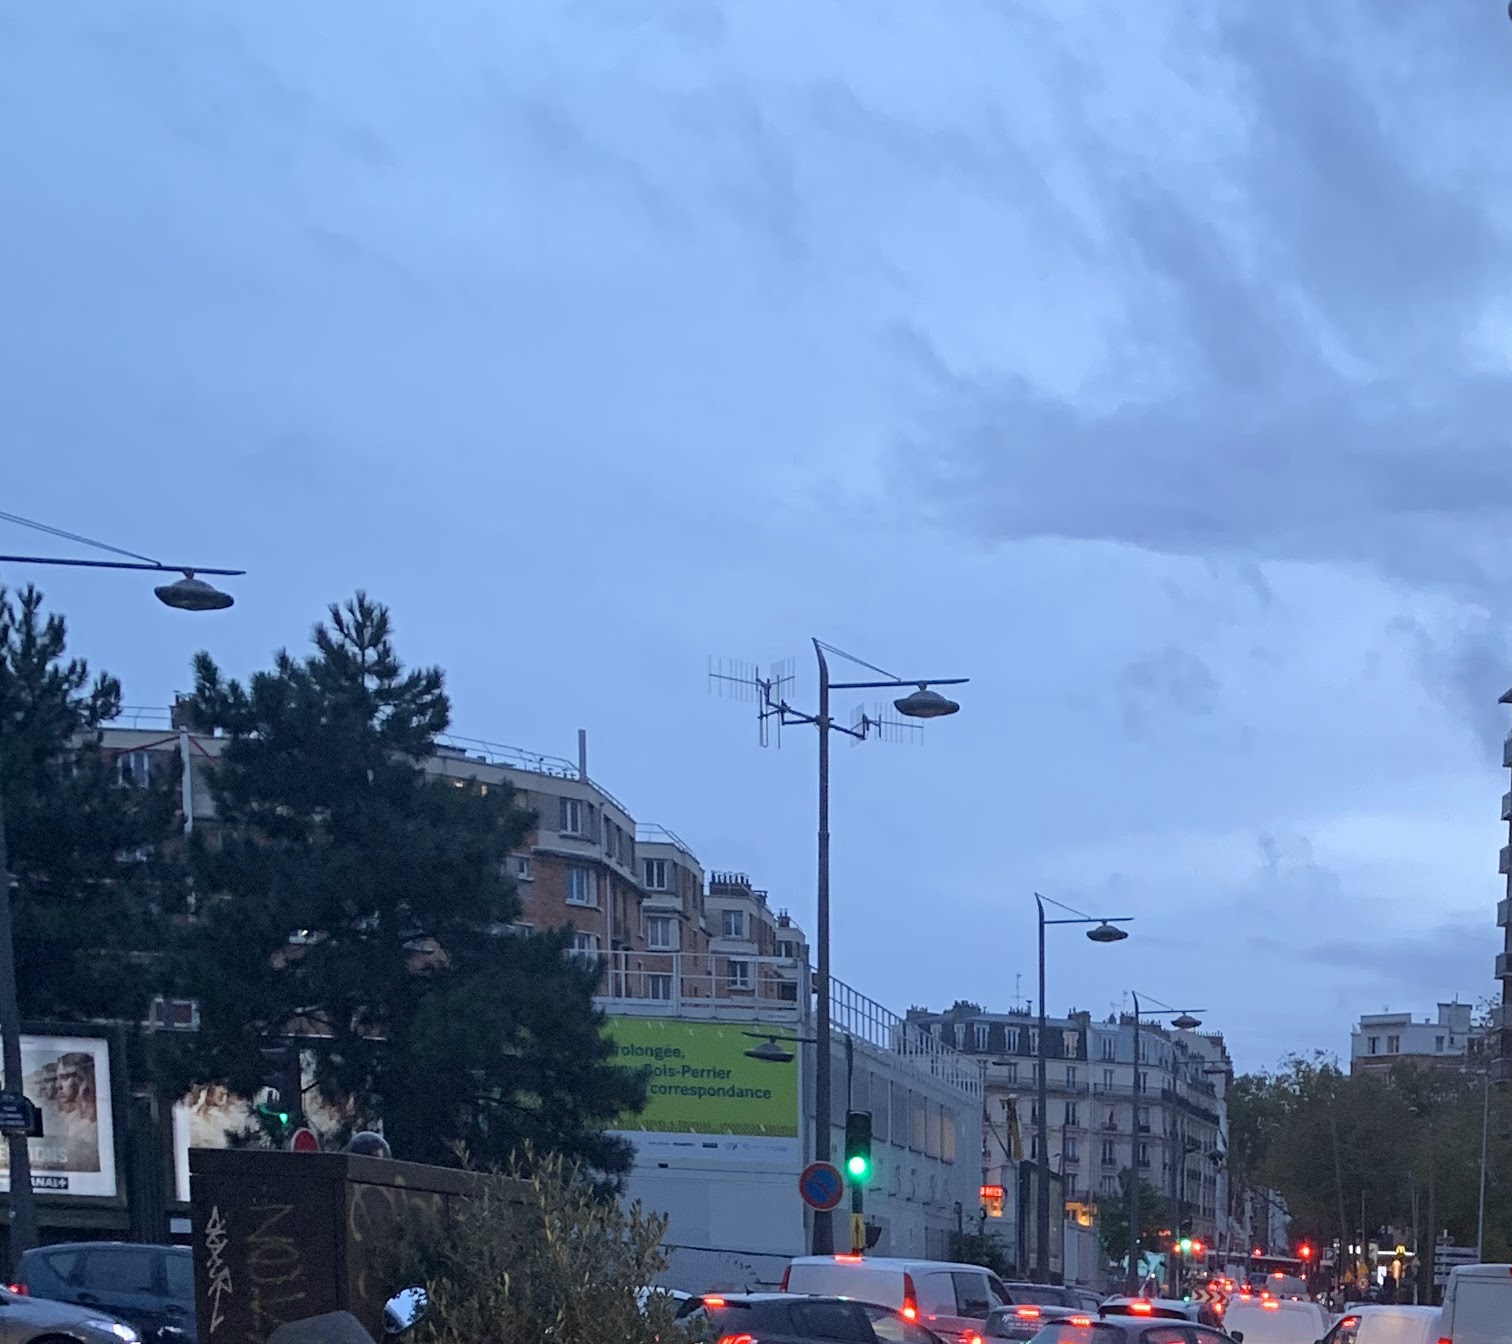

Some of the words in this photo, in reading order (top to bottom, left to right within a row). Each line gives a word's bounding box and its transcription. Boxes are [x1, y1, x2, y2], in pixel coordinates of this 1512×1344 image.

[613, 1043, 686, 1061] rolongée,
[651, 1082, 772, 1100] correspondance
[31, 1177, 67, 1189] NAL+
